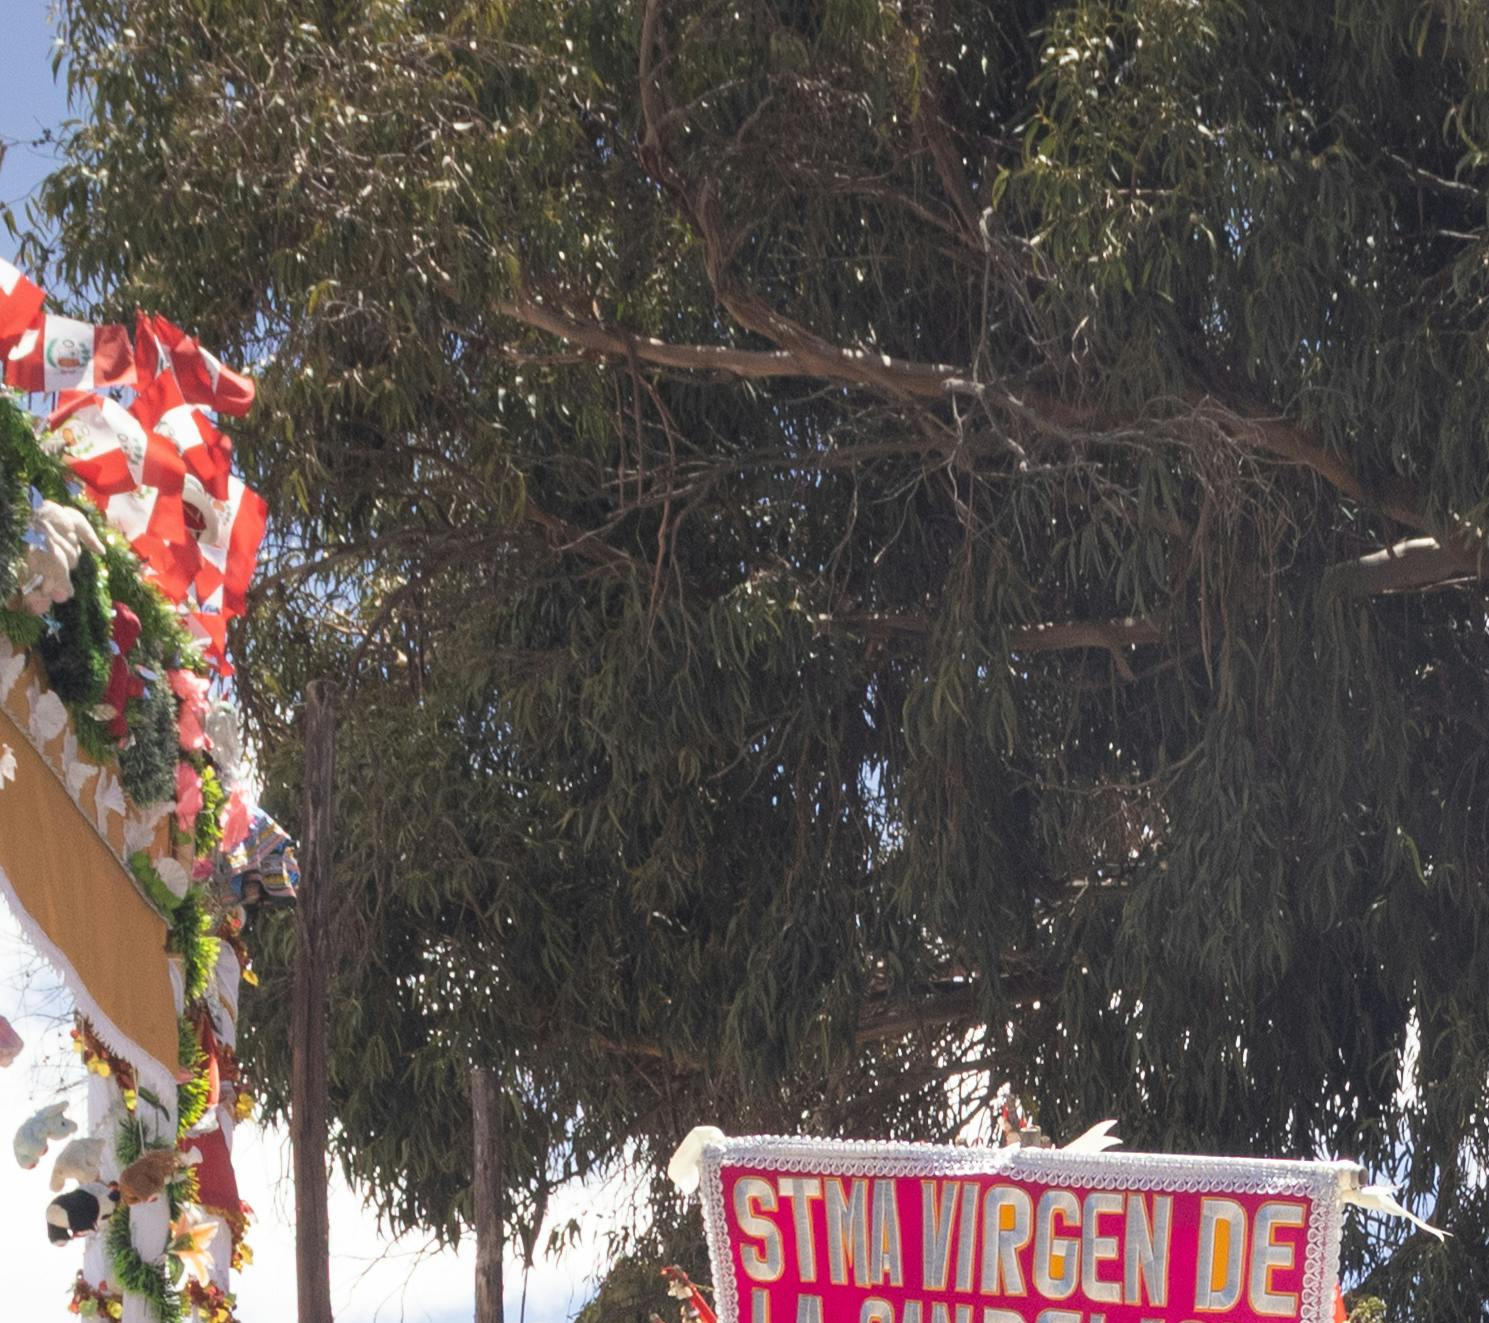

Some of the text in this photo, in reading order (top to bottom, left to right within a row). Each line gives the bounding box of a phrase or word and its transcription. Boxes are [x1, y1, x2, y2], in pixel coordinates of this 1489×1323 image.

[733, 1175, 1306, 1317] STMA VIRGEN DE
